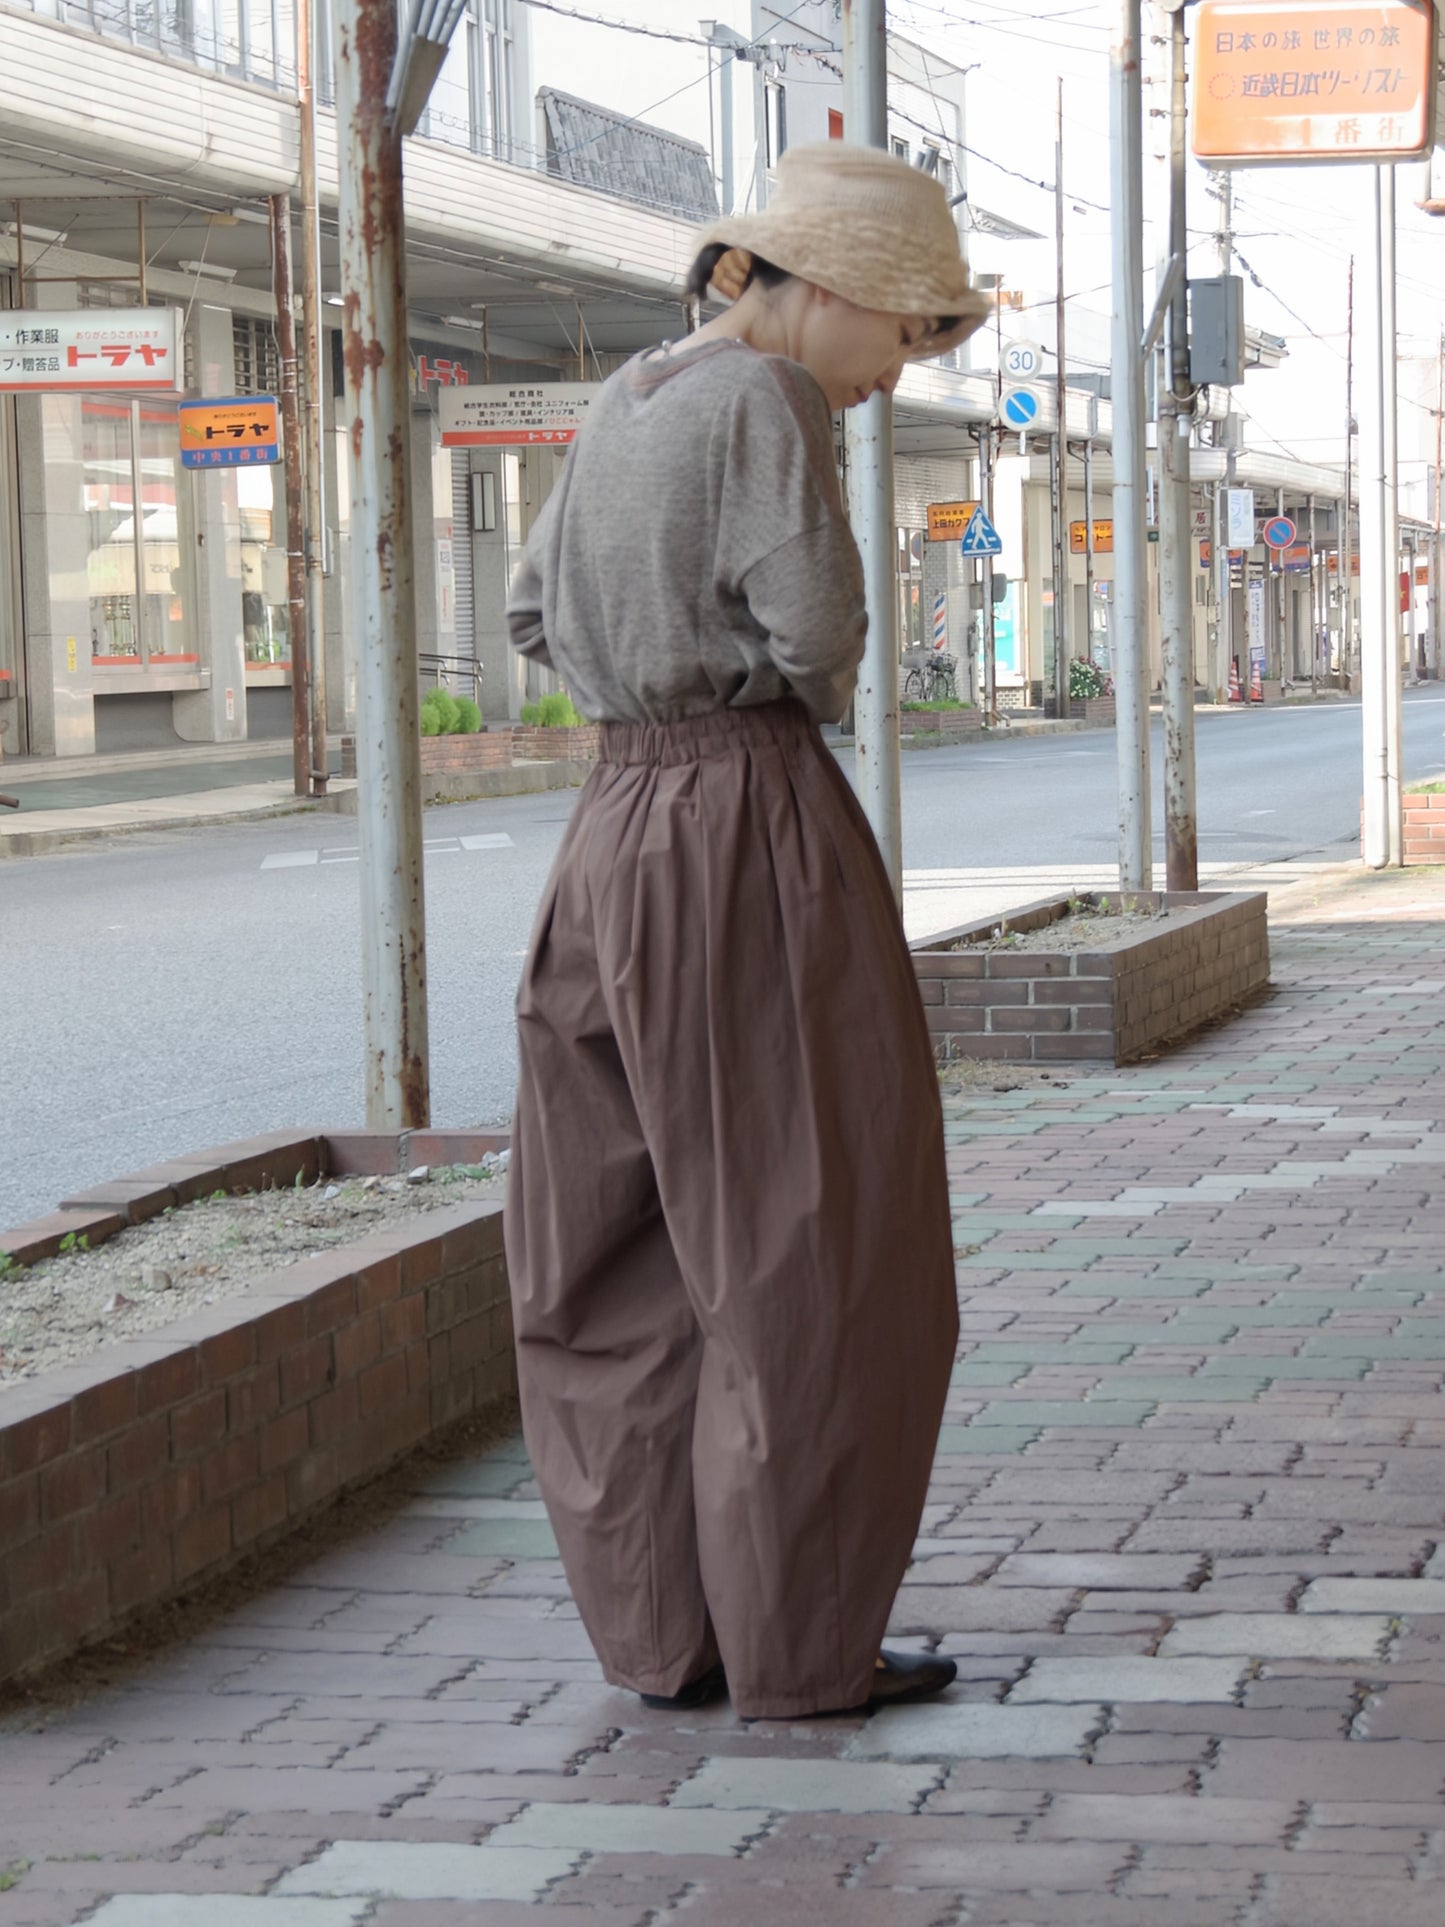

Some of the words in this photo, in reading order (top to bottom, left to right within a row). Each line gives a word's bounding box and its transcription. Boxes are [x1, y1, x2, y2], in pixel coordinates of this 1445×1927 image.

[1215, 30, 1301, 53] 日本の旅
[1313, 26, 1401, 50] 世界の旅
[1241, 68, 1408, 97] 近畿日本ツーリスト
[75, 330, 159, 340] ありがとうございます
[67, 344, 168, 367] トラヤ
[1009, 351, 1033, 370] 30
[205, 423, 270, 440] トラヤ
[528, 431, 568, 441] トラヤ
